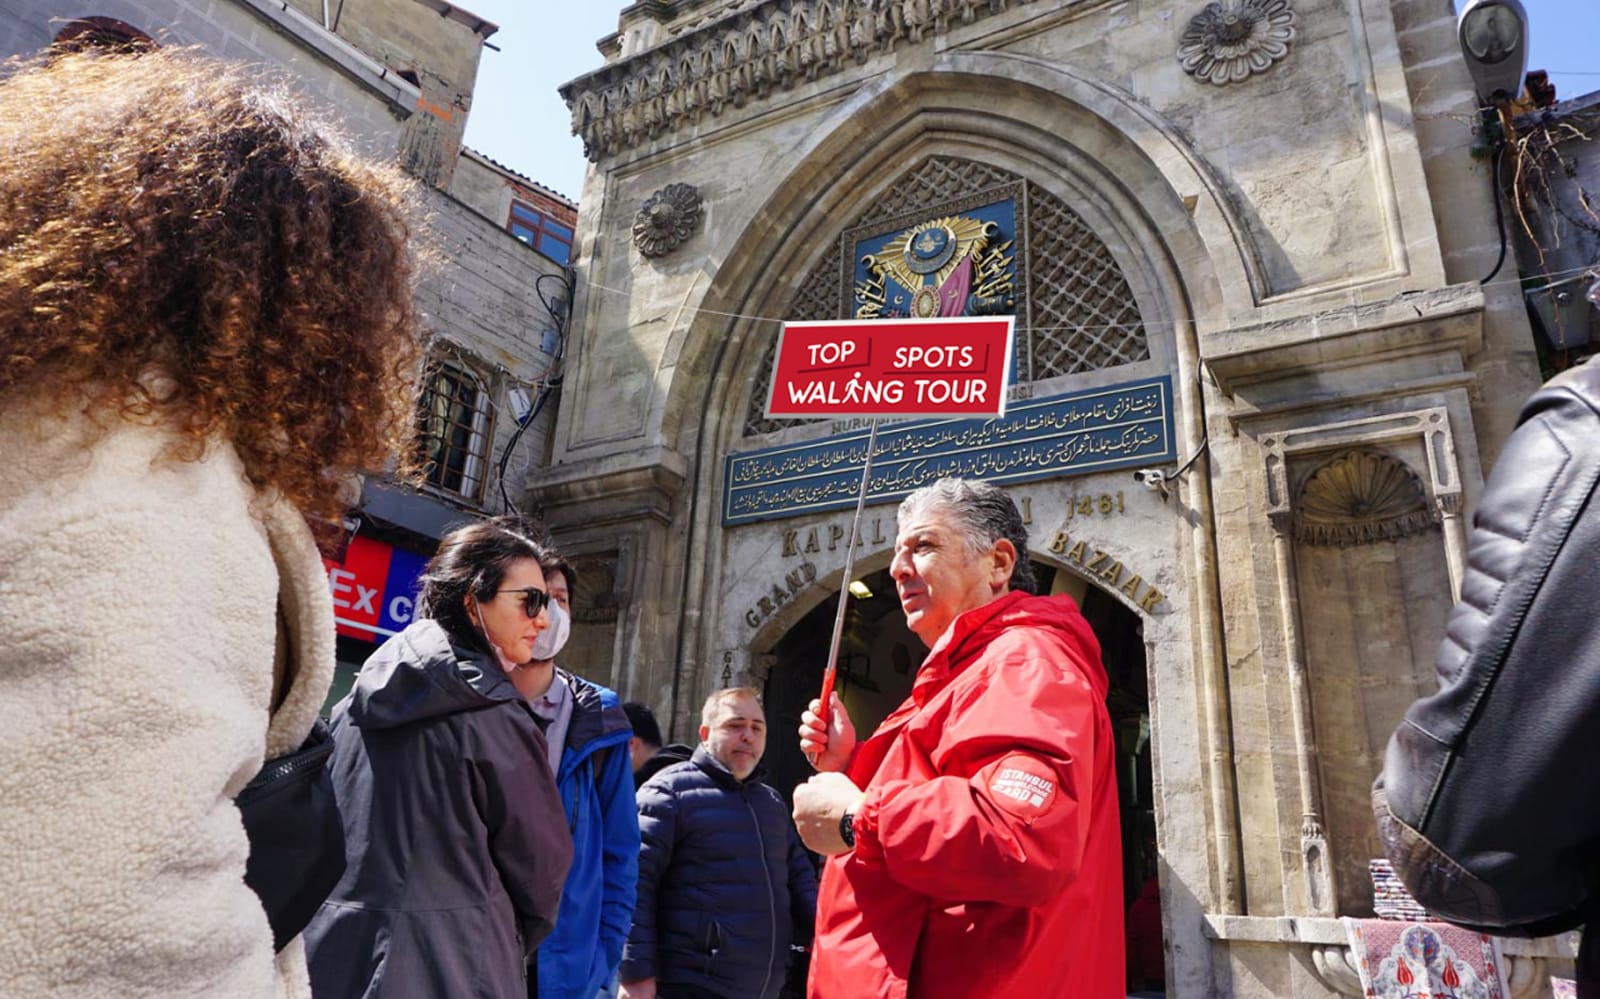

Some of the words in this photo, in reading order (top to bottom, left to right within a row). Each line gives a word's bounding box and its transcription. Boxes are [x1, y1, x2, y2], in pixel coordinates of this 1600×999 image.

[808, 340, 856, 365] TOP
[893, 346, 973, 368] SPOTS
[914, 379, 987, 404] TOUR
[1066, 490, 1124, 519] 1461
[782, 517, 898, 557] KAPAL
[745, 562, 817, 628] GRAND
[1048, 530, 1163, 613] BAZAAR
[721, 651, 733, 688] GAT
